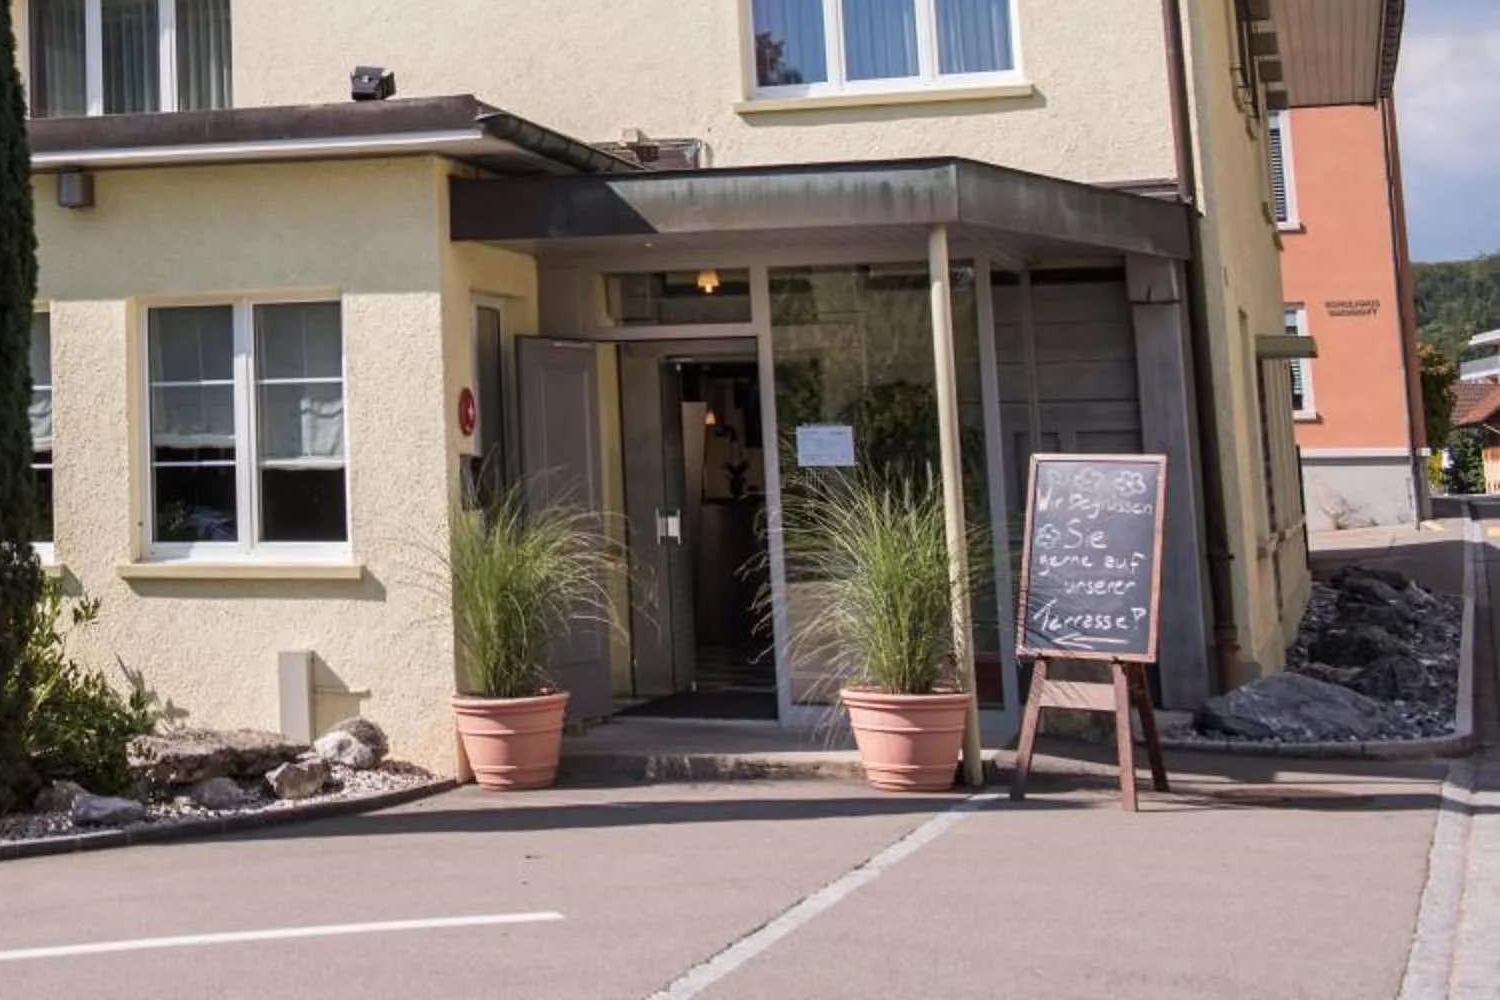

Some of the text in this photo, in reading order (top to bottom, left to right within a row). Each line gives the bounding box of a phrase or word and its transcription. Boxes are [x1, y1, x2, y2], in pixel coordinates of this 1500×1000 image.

[1036, 486, 1061, 512] Wir
[1063, 518, 1108, 549] Sie
[1038, 551, 1147, 577] gerne auf
[1063, 579, 1137, 595] unserer
